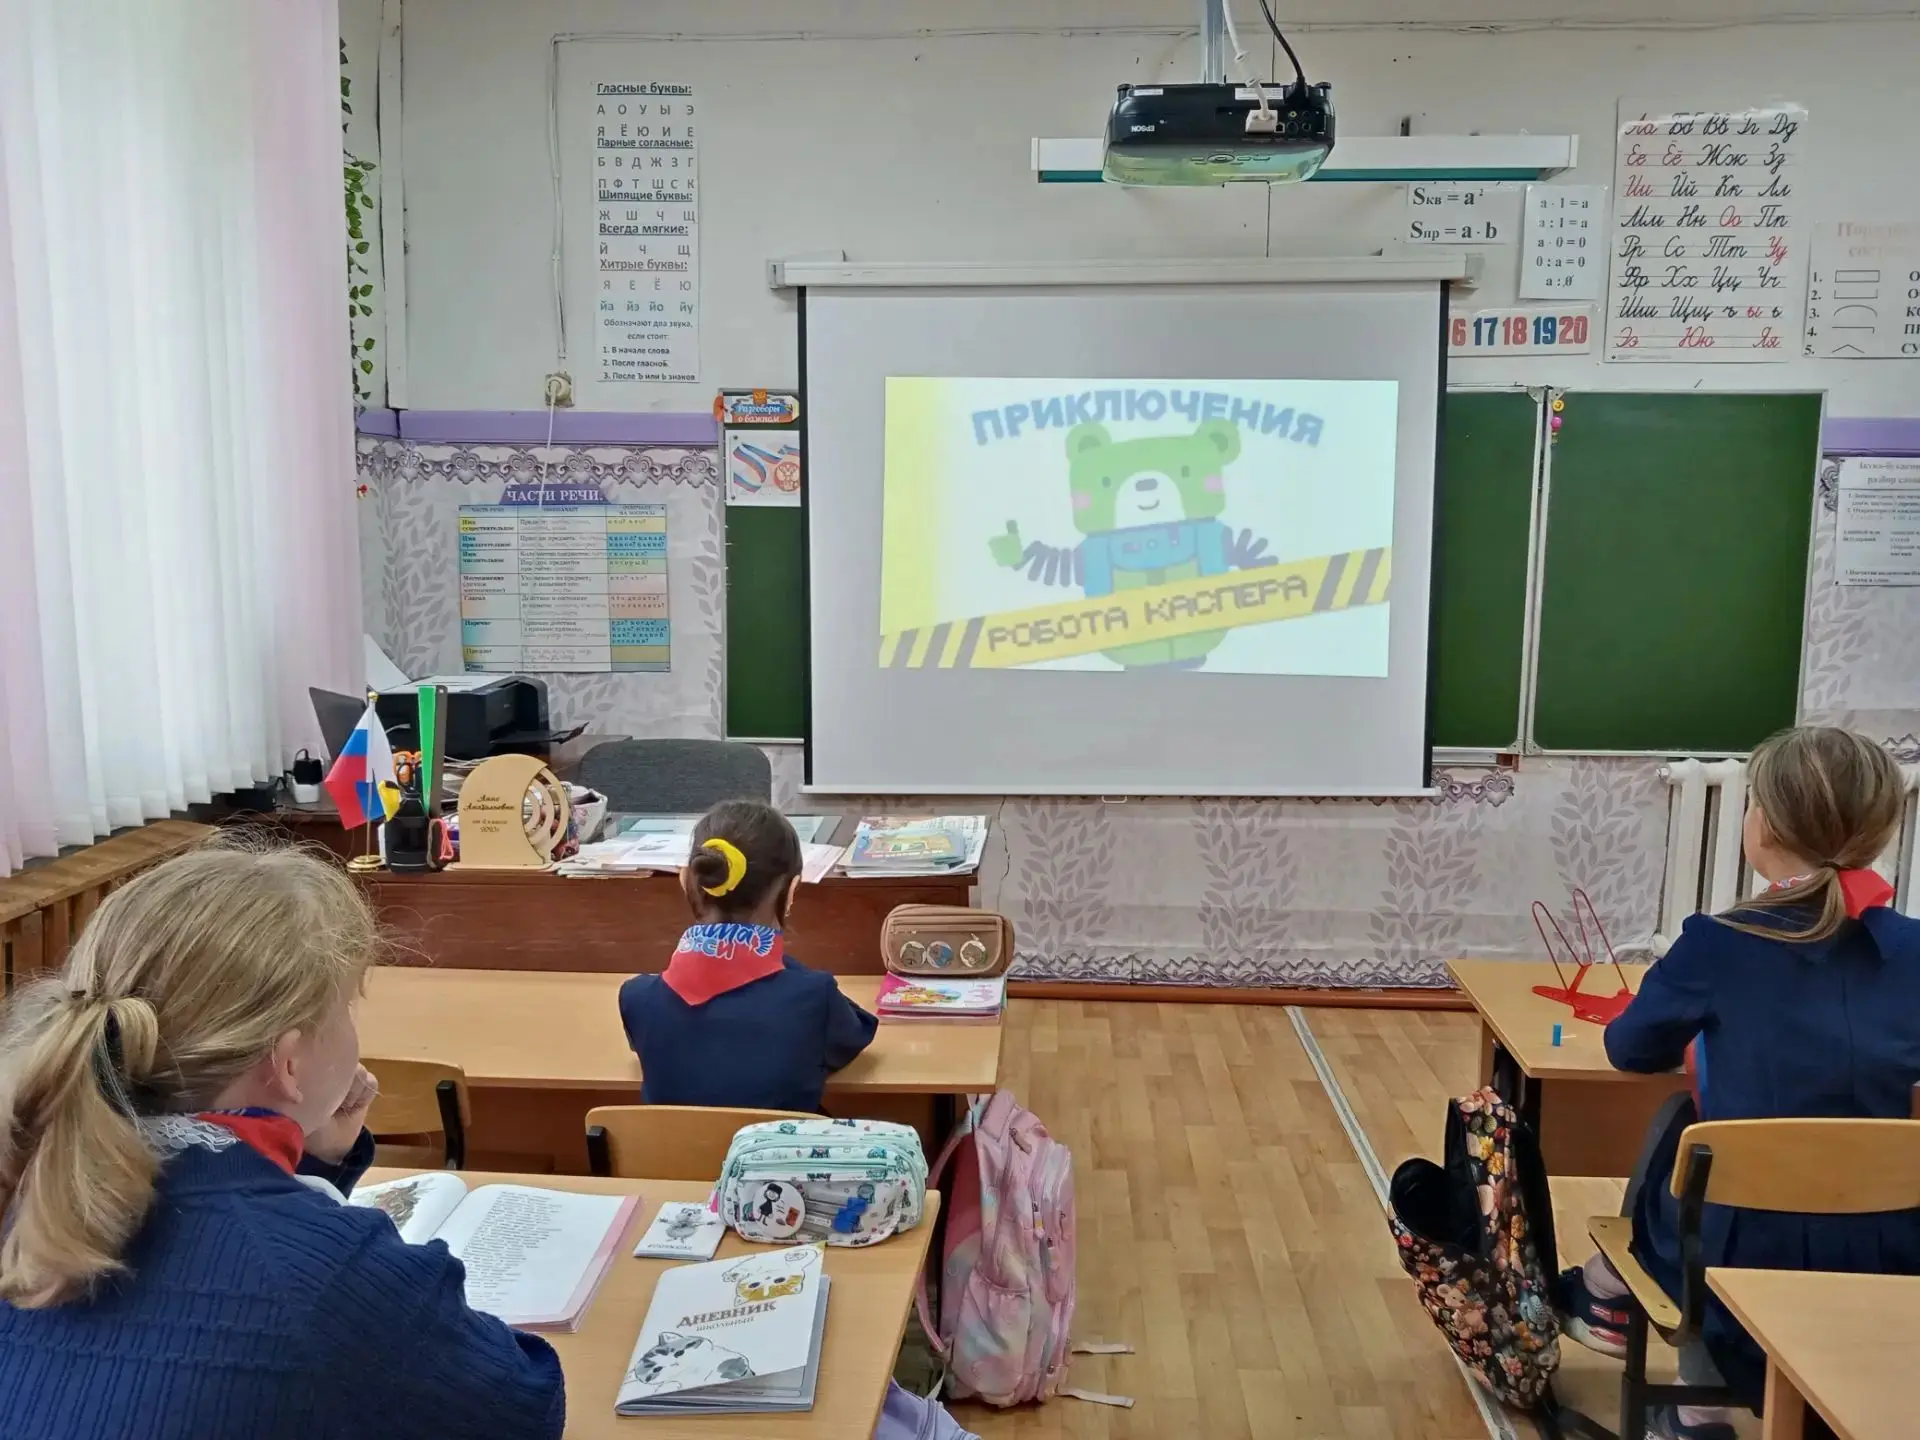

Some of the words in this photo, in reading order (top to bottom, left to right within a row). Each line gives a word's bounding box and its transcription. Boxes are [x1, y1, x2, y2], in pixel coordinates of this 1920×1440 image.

[597, 83, 647, 95] Гласные
[650, 82, 692, 95] буквы:
[597, 104, 605, 115] А
[618, 104, 627, 115] О
[640, 104, 647, 115] У
[660, 104, 671, 115] Ы
[686, 104, 694, 115] Э
[597, 126, 605, 137] Я
[621, 123, 628, 137] Ё
[637, 126, 649, 137] Ю
[662, 126, 671, 137] И
[687, 126, 694, 137] Е
[1131, 125, 1155, 133] EPSON
[1768, 113, 1797, 143] Дд
[597, 138, 636, 149] Парные
[638, 139, 693, 149] согласные:
[598, 157, 606, 167] Б
[616, 157, 623, 167] В
[632, 157, 641, 169] Д
[651, 157, 662, 167] Ж
[672, 158, 678, 167] З
[688, 158, 694, 167] Г
[1627, 144, 1647, 166] Ее
[1662, 140, 1683, 166] Ёё
[1697, 144, 1748, 166] Жж
[1764, 143, 1786, 174] Зз
[598, 178, 606, 188] П
[613, 178, 623, 188] Ф
[632, 179, 639, 189] Т
[652, 178, 664, 189] Ш
[670, 179, 678, 189] С
[687, 178, 695, 189] К
[1626, 175, 1653, 197] Ии
[1671, 171, 1698, 197] Йй
[1715, 175, 1743, 197] Кк
[1758, 176, 1791, 197] Лл
[599, 190, 653, 202] Шипящие
[655, 190, 693, 202] буквы:
[600, 210, 610, 220] Ж
[626, 210, 638, 220] Ш
[656, 210, 664, 221] Ч
[683, 210, 695, 222] Щ
[1621, 205, 1665, 227] Мм
[1677, 205, 1706, 227] Нн
[1720, 205, 1742, 227] Оо
[1754, 205, 1788, 227] Пп
[599, 223, 639, 236] Всегда
[642, 225, 688, 236] мягкие:
[1485, 221, 1497, 238] b
[600, 241, 608, 254] Й
[639, 245, 647, 255] Ч
[678, 245, 690, 257] Щ
[1619, 235, 1645, 266] Рр
[1664, 235, 1686, 258] Сс
[1703, 235, 1748, 258] Тт
[1765, 236, 1788, 266] Уу
[600, 259, 644, 271] Хитрые
[646, 259, 688, 271] буквы:
[603, 280, 611, 290] Я
[630, 280, 636, 290] Е
[654, 276, 661, 290] Ё
[680, 280, 691, 291] Ю
[1619, 266, 1649, 296] Фф
[1661, 265, 1699, 287] Хх
[1711, 266, 1742, 293] Цц
[1758, 266, 1781, 287] Чч
[1619, 296, 1659, 318] Шш
[1670, 296, 1714, 323] Щщ
[1722, 306, 1738, 318] ъ
[1747, 306, 1763, 318] ы
[1772, 306, 1783, 318] ь
[1448, 318, 1467, 346] 6
[1473, 317, 1499, 346] 17
[1502, 317, 1527, 346] 18
[1532, 316, 1557, 345] 19
[1558, 315, 1588, 345] 20
[1616, 327, 1639, 347] Ээ
[1678, 326, 1716, 347] Юю
[1752, 326, 1780, 347] Яя
[971, 389, 1325, 448] ПРИКЛЮЧЕНИЯ
[506, 490, 556, 501] ЧАСТИ
[560, 489, 603, 501] РЕЧИ.
[987, 606, 1129, 653] РОБОТА
[1144, 575, 1309, 626] КАСПЕРА
[676, 1300, 777, 1329] ДНЕВНИК
